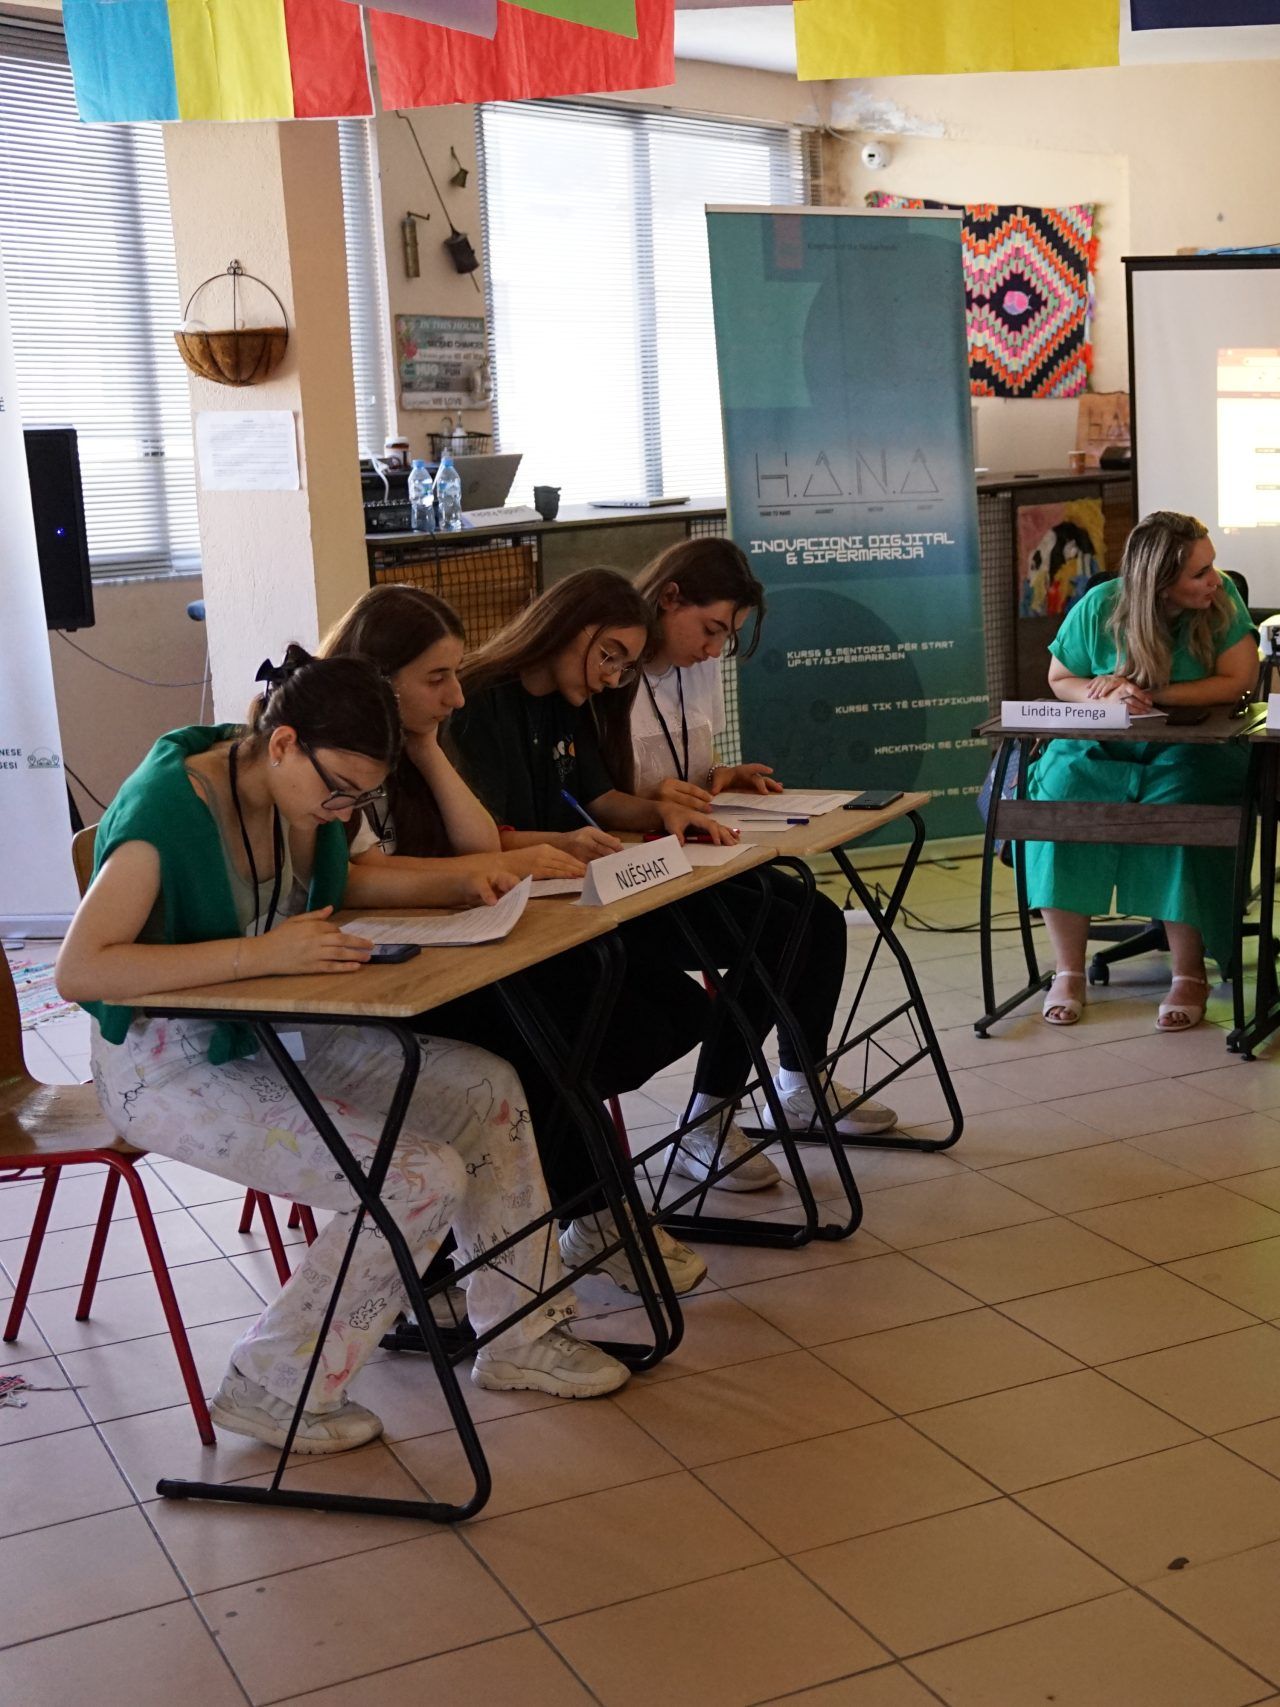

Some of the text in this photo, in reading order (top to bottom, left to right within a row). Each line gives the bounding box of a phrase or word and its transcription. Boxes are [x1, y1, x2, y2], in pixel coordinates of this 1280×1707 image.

[750, 532, 955, 554] INOVACIONI DIGJITAL
[921, 640, 955, 650] START
[835, 703, 869, 715] KURSE
[872, 701, 892, 711] TIK
[1021, 705, 1106, 720] Lindita Prenga
[874, 742, 936, 755] HACKATHON
[615, 857, 671, 891] NJËSHAT
